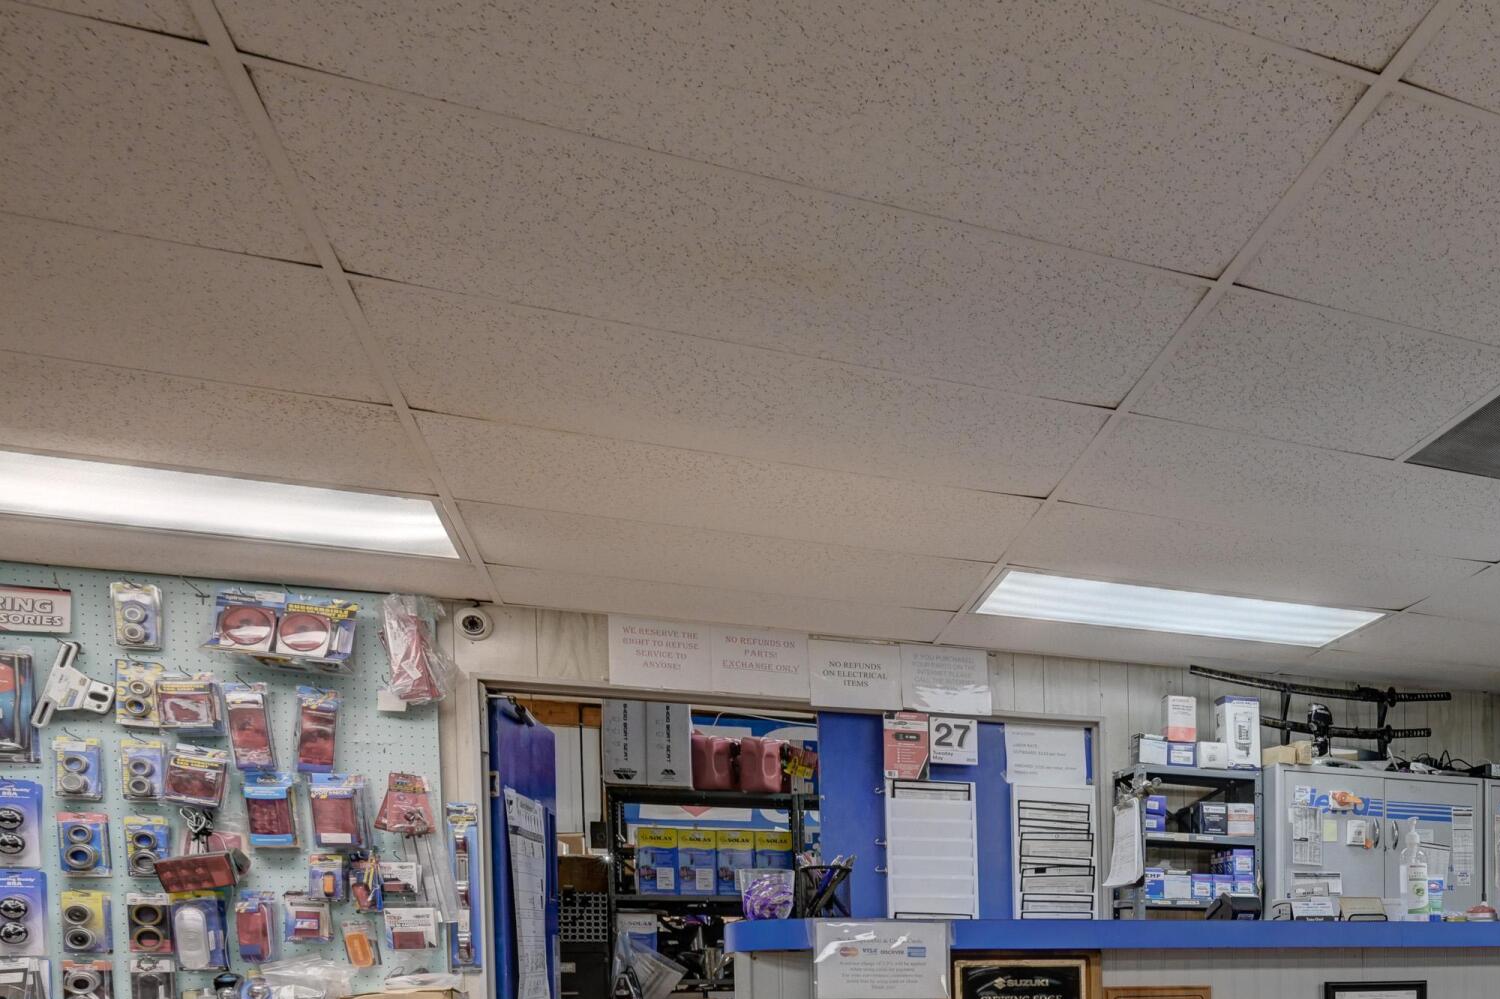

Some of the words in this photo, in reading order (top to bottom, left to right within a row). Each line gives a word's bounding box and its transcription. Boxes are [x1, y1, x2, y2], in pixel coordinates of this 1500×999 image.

[622, 626, 635, 635] WE
[639, 628, 678, 638] RESERVE
[681, 631, 698, 639] THE
[622, 638, 649, 646] RIGHT
[652, 639, 664, 648] TO
[666, 641, 699, 650] REFUSE
[725, 636, 737, 644] NO
[740, 637, 781, 648] REFUNDS
[782, 641, 796, 649] ON
[635, 650, 673, 658] SERVICE
[722, 659, 773, 671] EXCHANGE
[775, 664, 800, 673] ONLY
[843, 662, 882, 670] REFUNDS
[838, 671, 888, 680] ELECTRICAL
[934, 722, 970, 749] 27
[932, 750, 953, 758] Tuesday
[1006, 979, 1049, 987] SUZUKI
